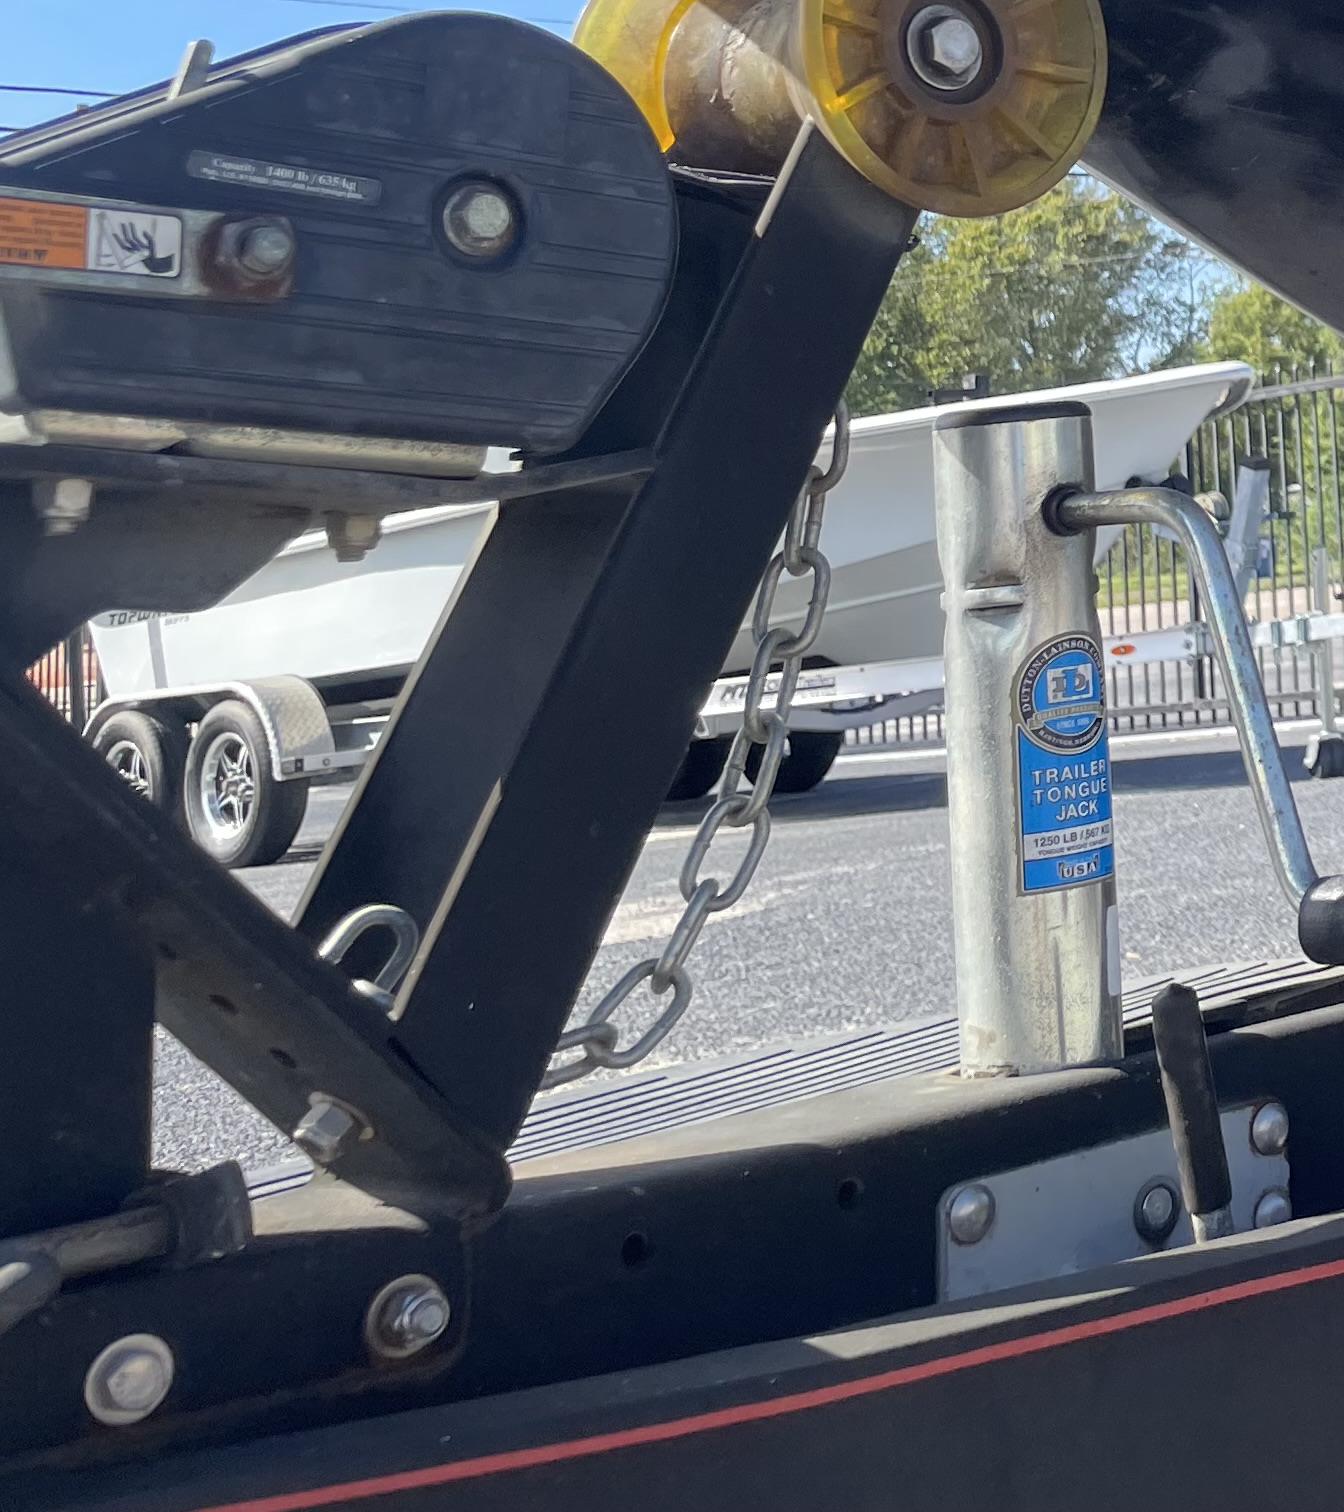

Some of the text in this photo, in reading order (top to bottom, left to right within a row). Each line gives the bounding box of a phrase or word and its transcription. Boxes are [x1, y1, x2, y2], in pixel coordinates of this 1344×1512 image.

[319, 175, 340, 187] 635
[342, 177, 358, 192] kg
[1031, 758, 1107, 786] TRAILER
[1032, 778, 1108, 805] TONGUE
[1055, 800, 1099, 822] JACK
[1034, 835, 1060, 848] 1250
[1063, 832, 1078, 844] LB
